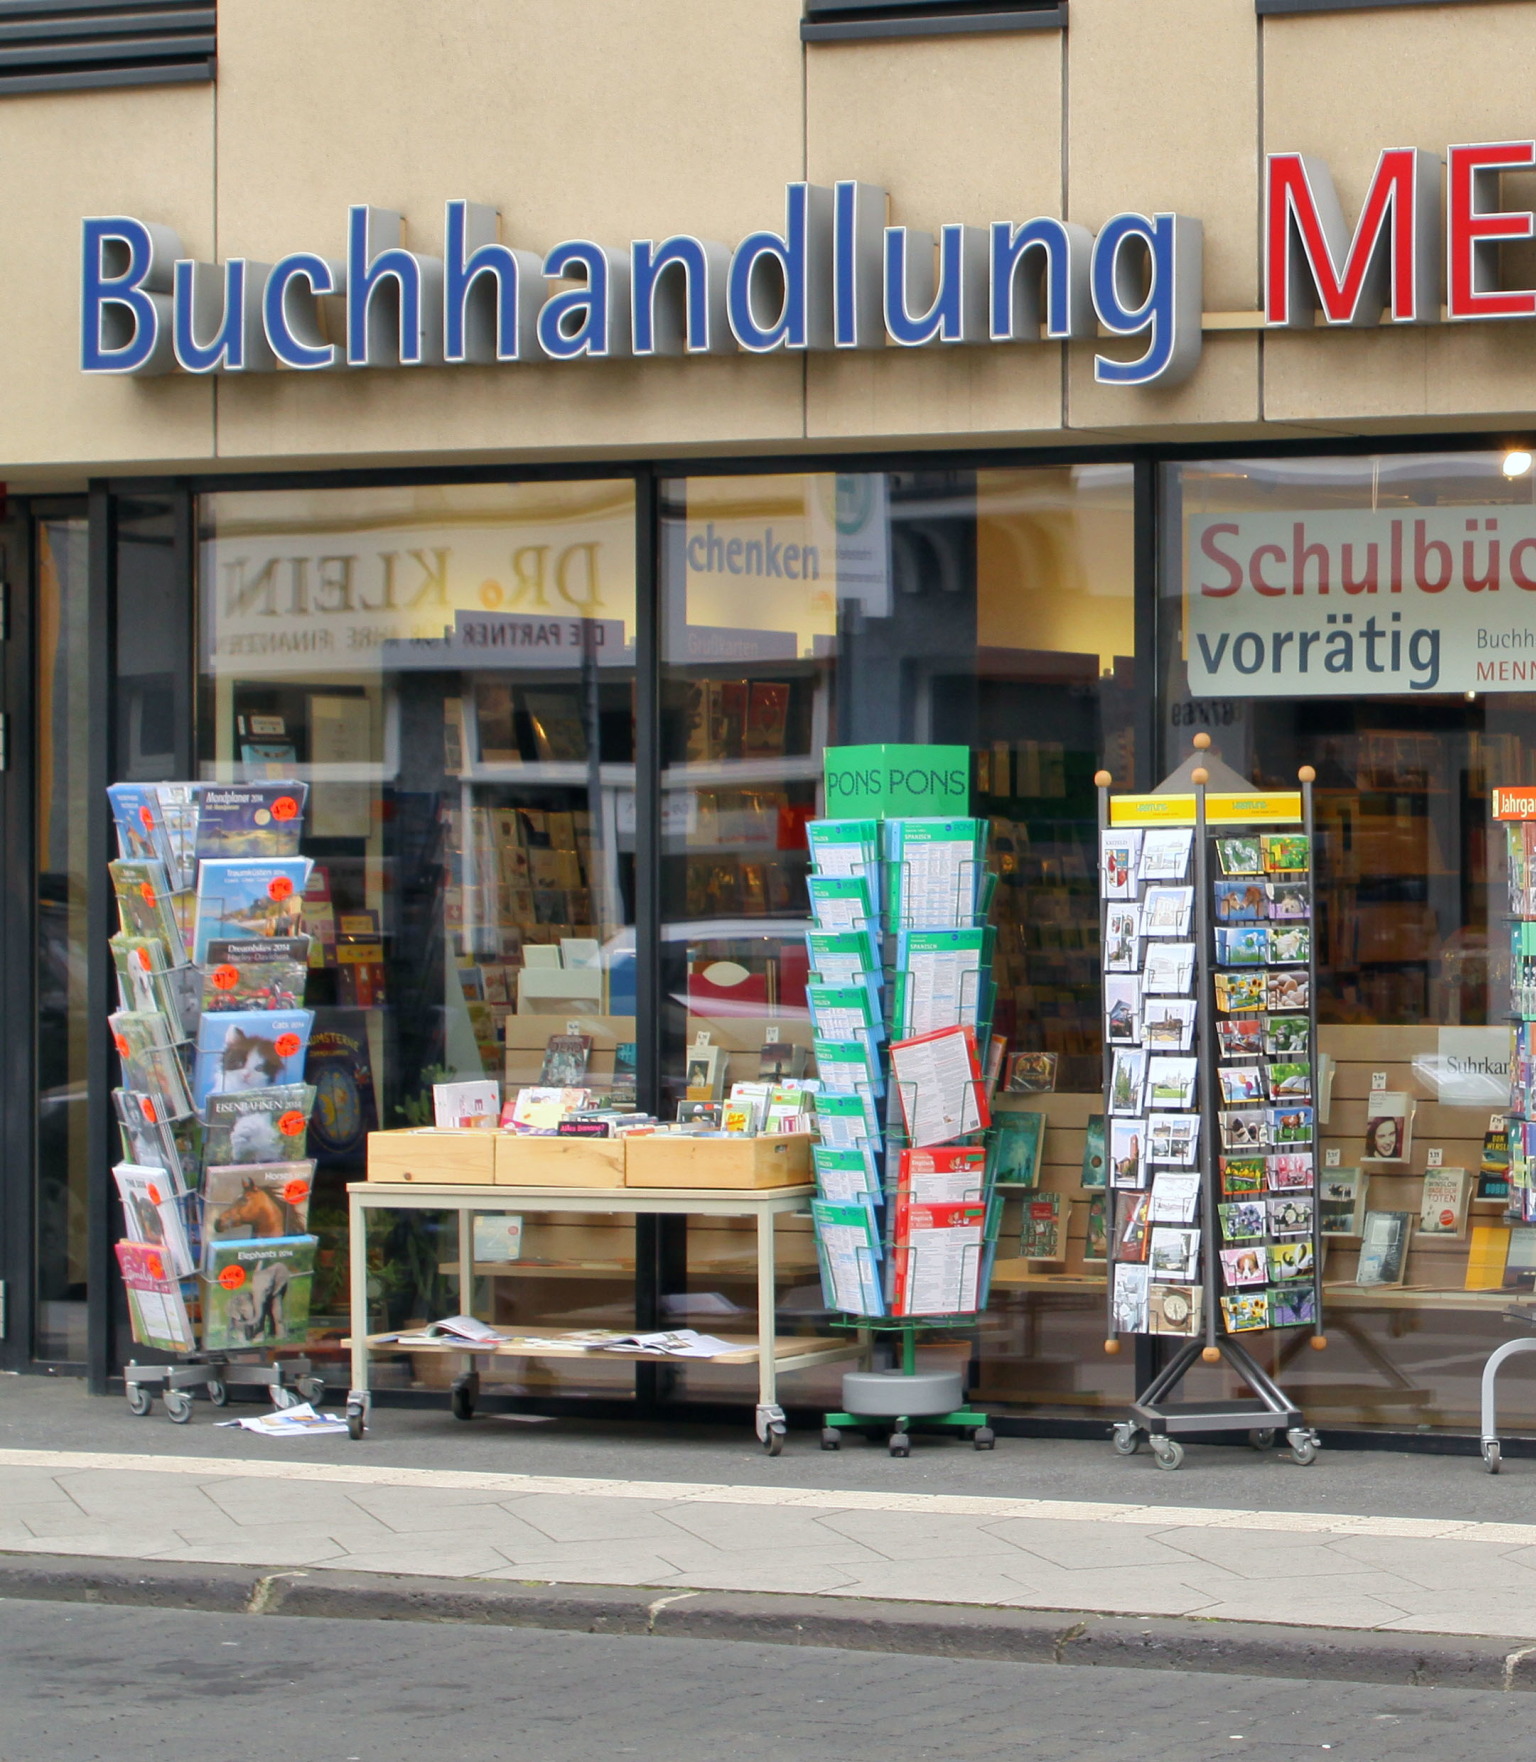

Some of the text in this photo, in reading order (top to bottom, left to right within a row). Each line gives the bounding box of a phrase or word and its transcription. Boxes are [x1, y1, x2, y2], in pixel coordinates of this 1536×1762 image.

[81, 180, 1179, 384] Buchhandlung
[1196, 611, 1441, 690] vorrätig
[828, 769, 882, 798] PONS
[889, 769, 966, 796] PONS
[206, 791, 250, 804] Mondplaner
[272, 1020, 289, 1029] Cats
[1447, 1056, 1509, 1075] Suhrka
[215, 1102, 283, 1113] EISENBAHNEN
[1486, 1142, 1508, 1151] WINSL
[264, 1172, 292, 1181] Horses
[1428, 1194, 1457, 1203] TOTEN
[238, 1251, 277, 1261] Elephants
